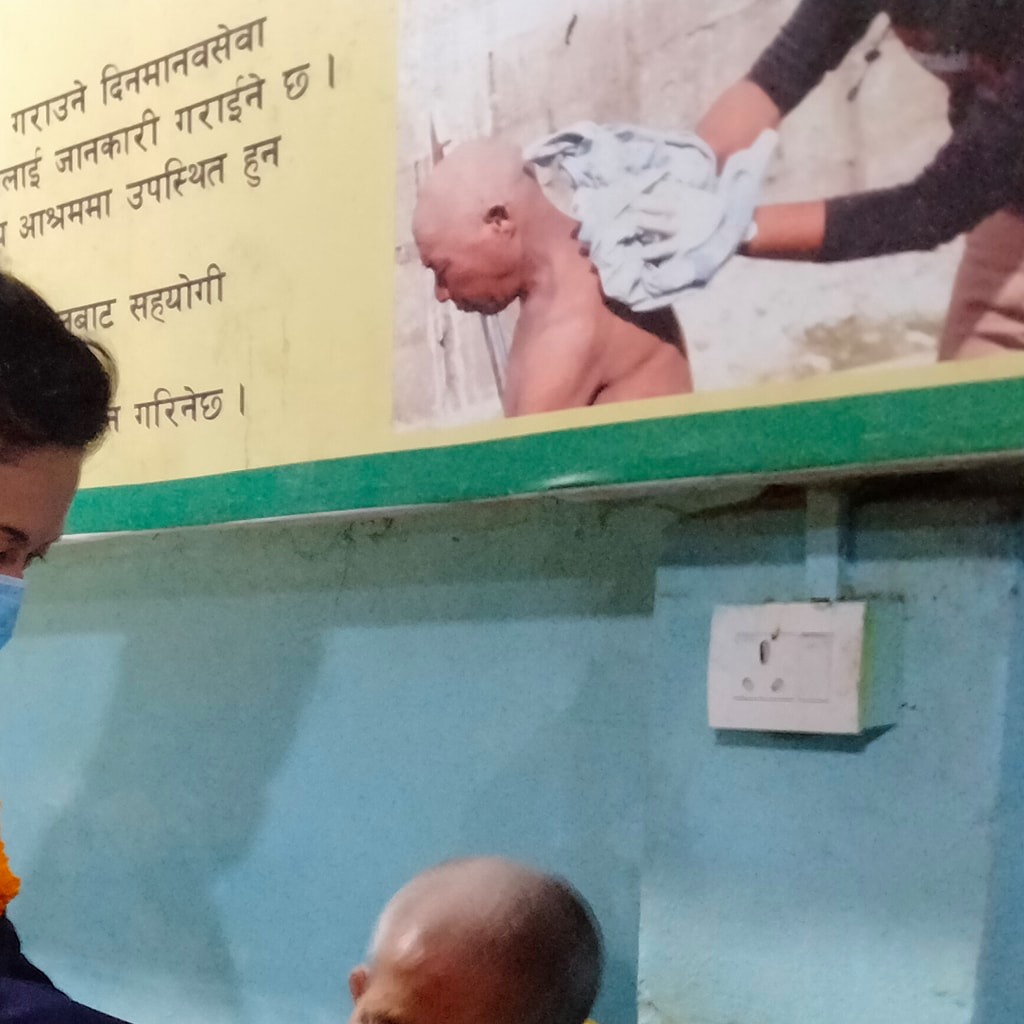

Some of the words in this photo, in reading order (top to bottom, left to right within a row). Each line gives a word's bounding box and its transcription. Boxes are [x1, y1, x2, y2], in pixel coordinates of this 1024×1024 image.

[11, 80, 87, 135] गराउने
[100, 16, 267, 106] दिनमानवसेवा
[55, 108, 160, 173] जानकारी
[175, 73, 266, 134] गराईने
[282, 63, 310, 100] छ
[19, 189, 113, 239] आश्रममा
[126, 153, 228, 210] उपस्थित
[243, 135, 282, 187] हुन
[129, 263, 226, 323] सहयोगी
[134, 386, 223, 429] गरिनेछ
